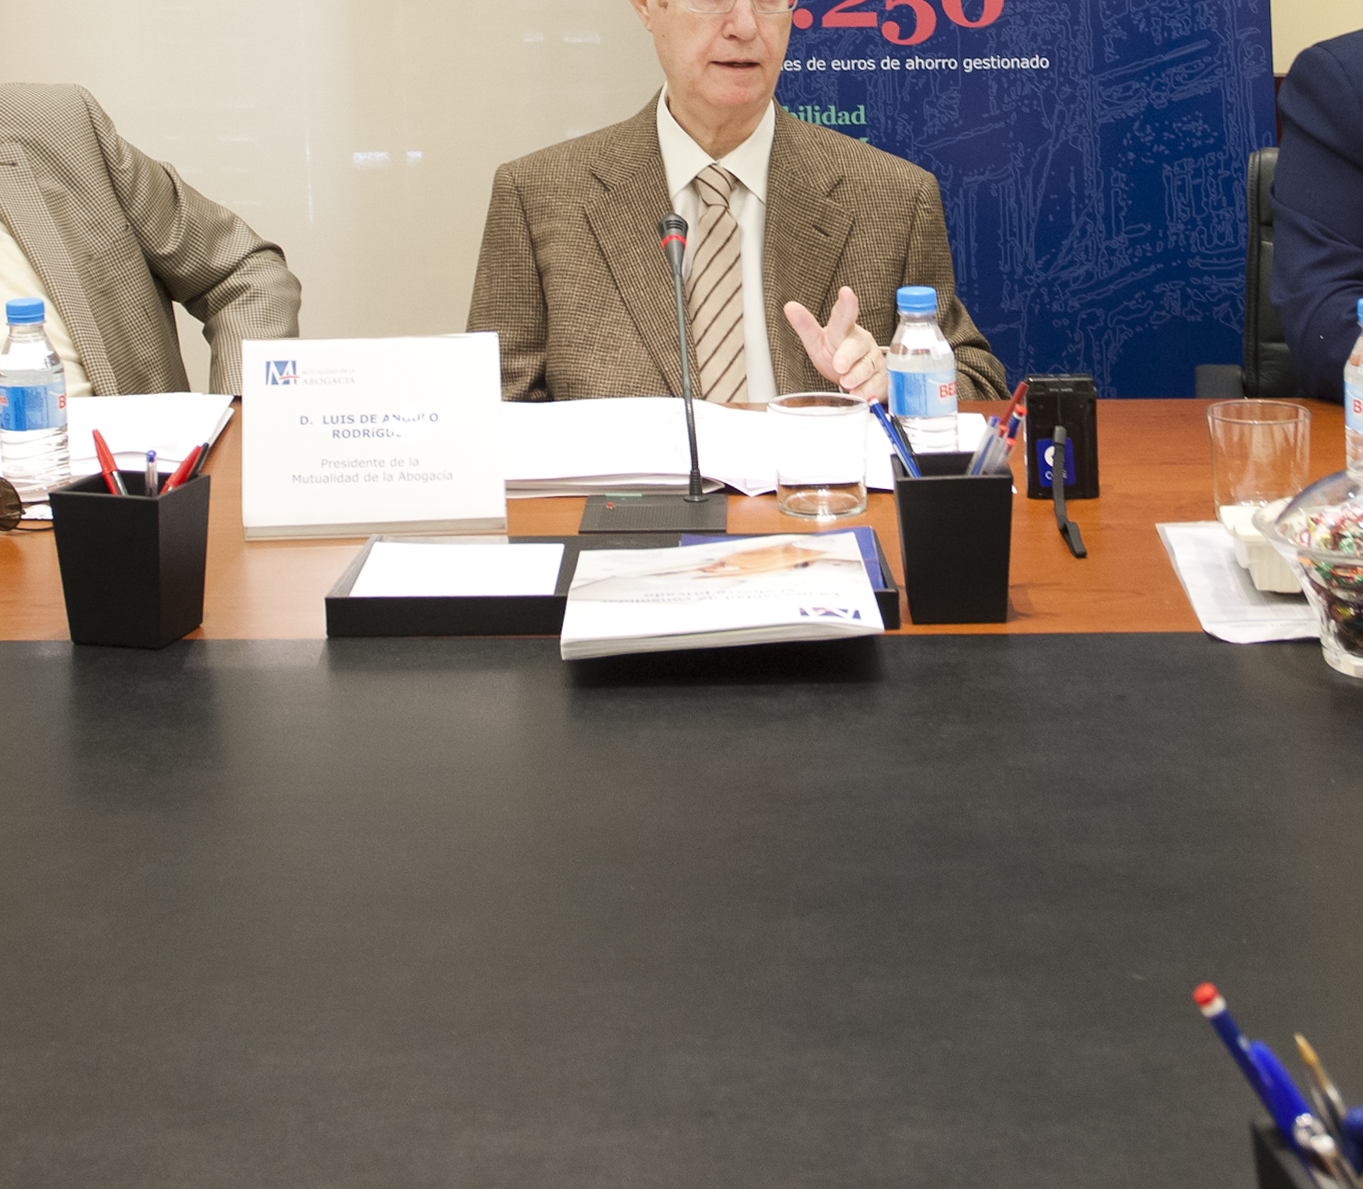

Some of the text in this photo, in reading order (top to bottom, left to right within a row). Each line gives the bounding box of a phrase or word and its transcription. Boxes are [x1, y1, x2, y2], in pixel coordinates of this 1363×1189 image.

[806, 56, 827, 71] de
[831, 58, 876, 71] euros
[881, 56, 900, 71] de
[905, 56, 958, 71] ahorro
[963, 54, 1050, 72] gestionado
[299, 415, 314, 426] D.
[322, 414, 355, 425] LUIS
[360, 413, 377, 424] DE
[320, 457, 419, 469] Presidente de la
[291, 470, 454, 484] Mutualidad de la Abogacía
